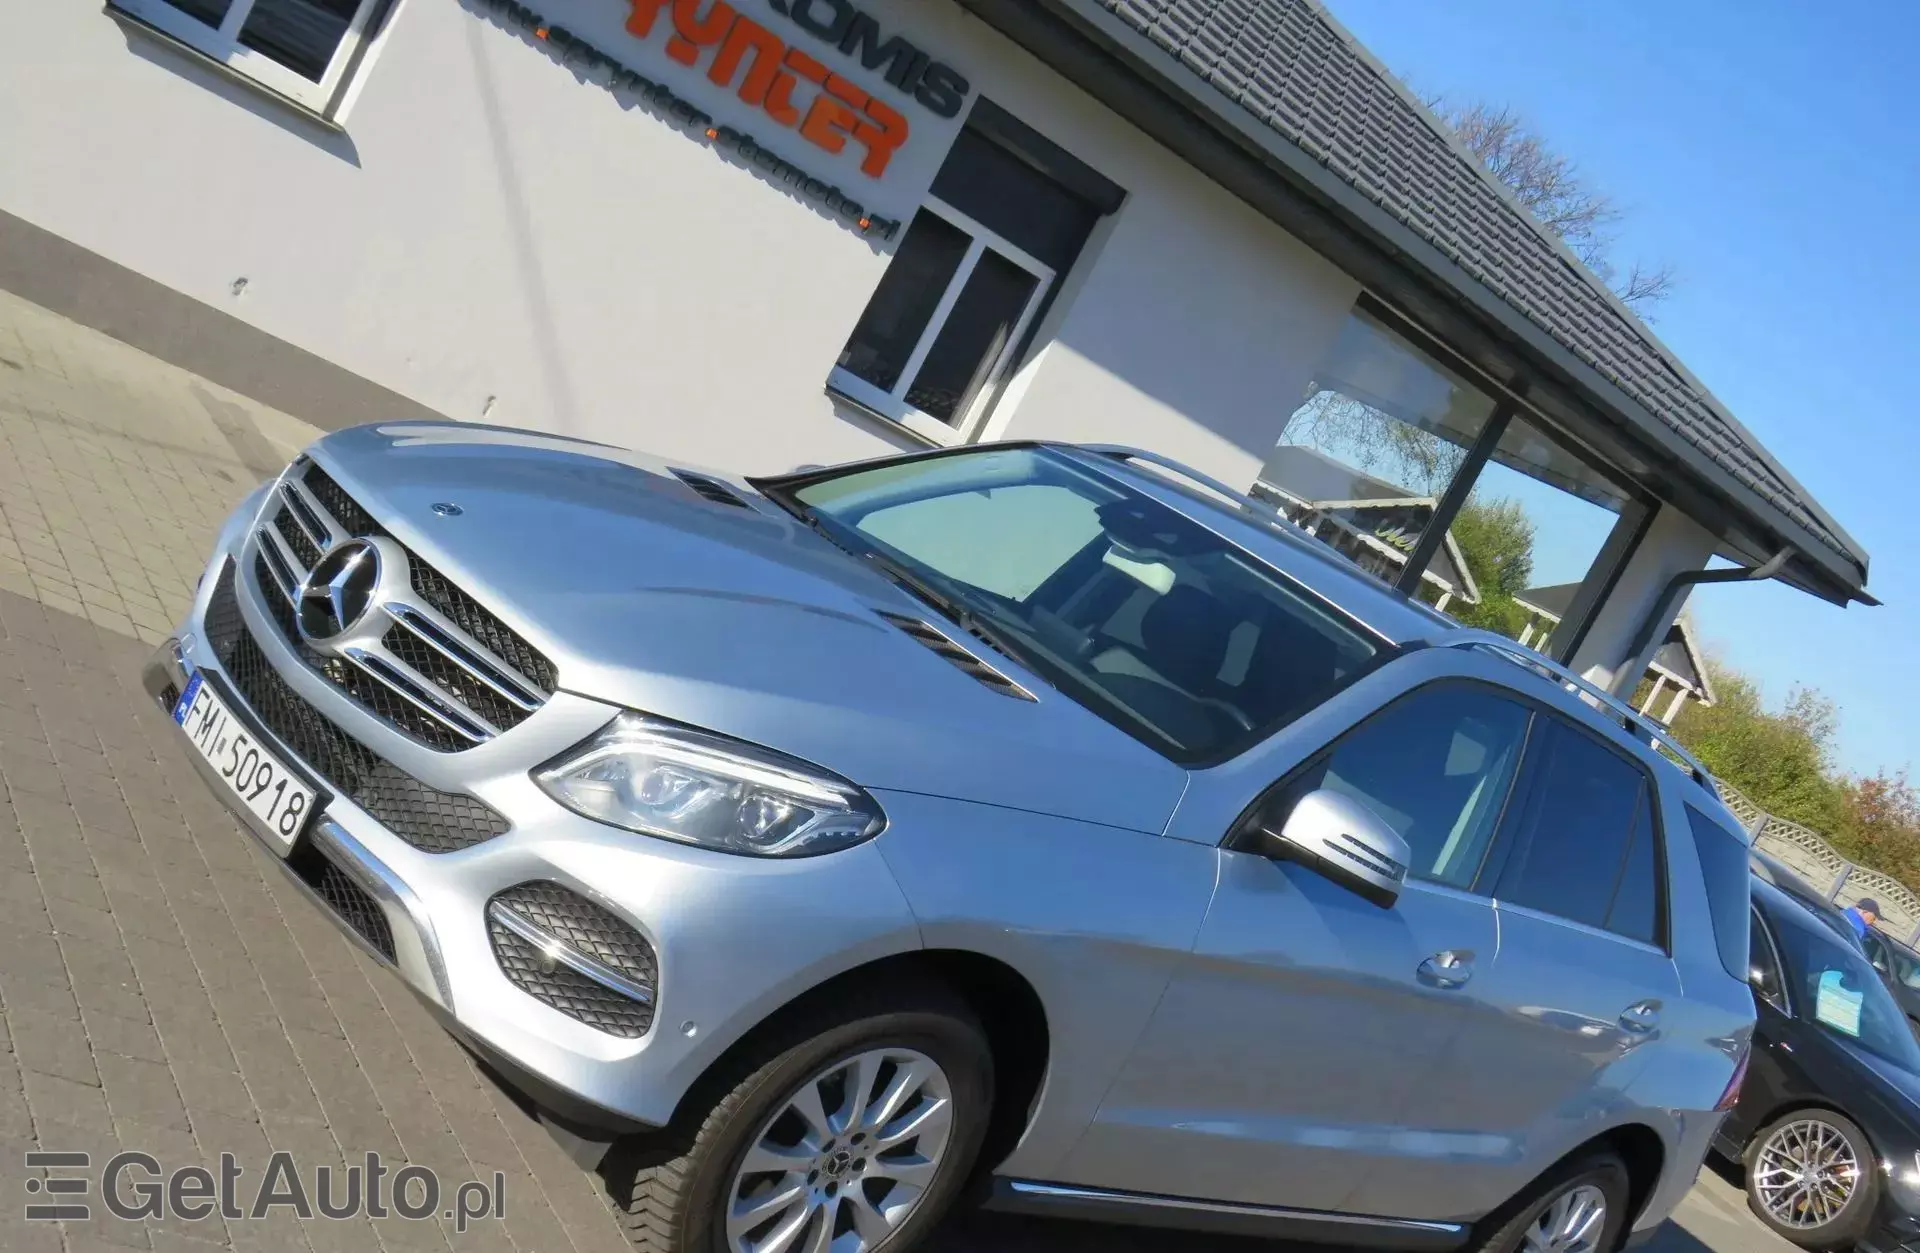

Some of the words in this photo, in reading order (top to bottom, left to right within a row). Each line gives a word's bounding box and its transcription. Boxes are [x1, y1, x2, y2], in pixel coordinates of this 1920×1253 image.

[767, 0, 970, 119] OMIS
[185, 687, 227, 757] FMI
[222, 733, 305, 836] 50918
